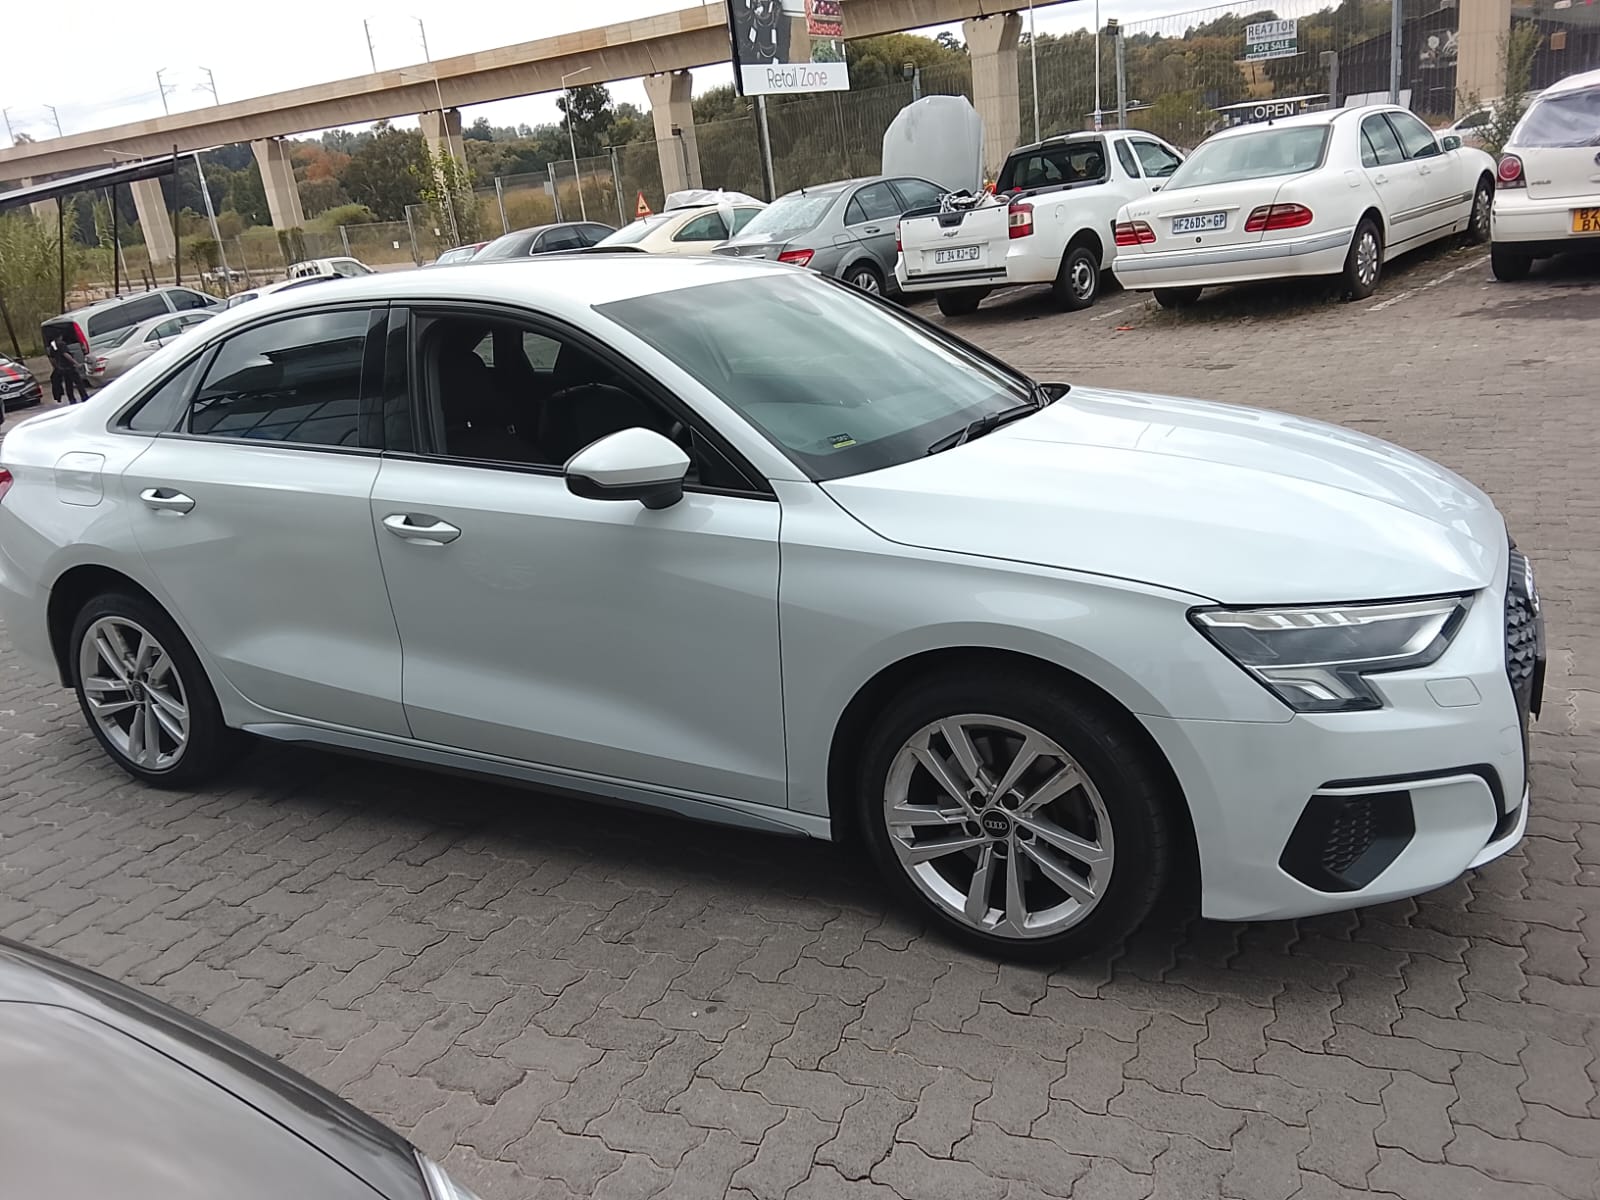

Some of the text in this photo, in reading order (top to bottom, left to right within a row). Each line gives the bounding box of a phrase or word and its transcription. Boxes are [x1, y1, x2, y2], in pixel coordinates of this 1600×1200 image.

[1253, 39, 1290, 53] FOR SALE
[766, 67, 829, 88] Retail Zone
[1254, 103, 1295, 119] OPEN
